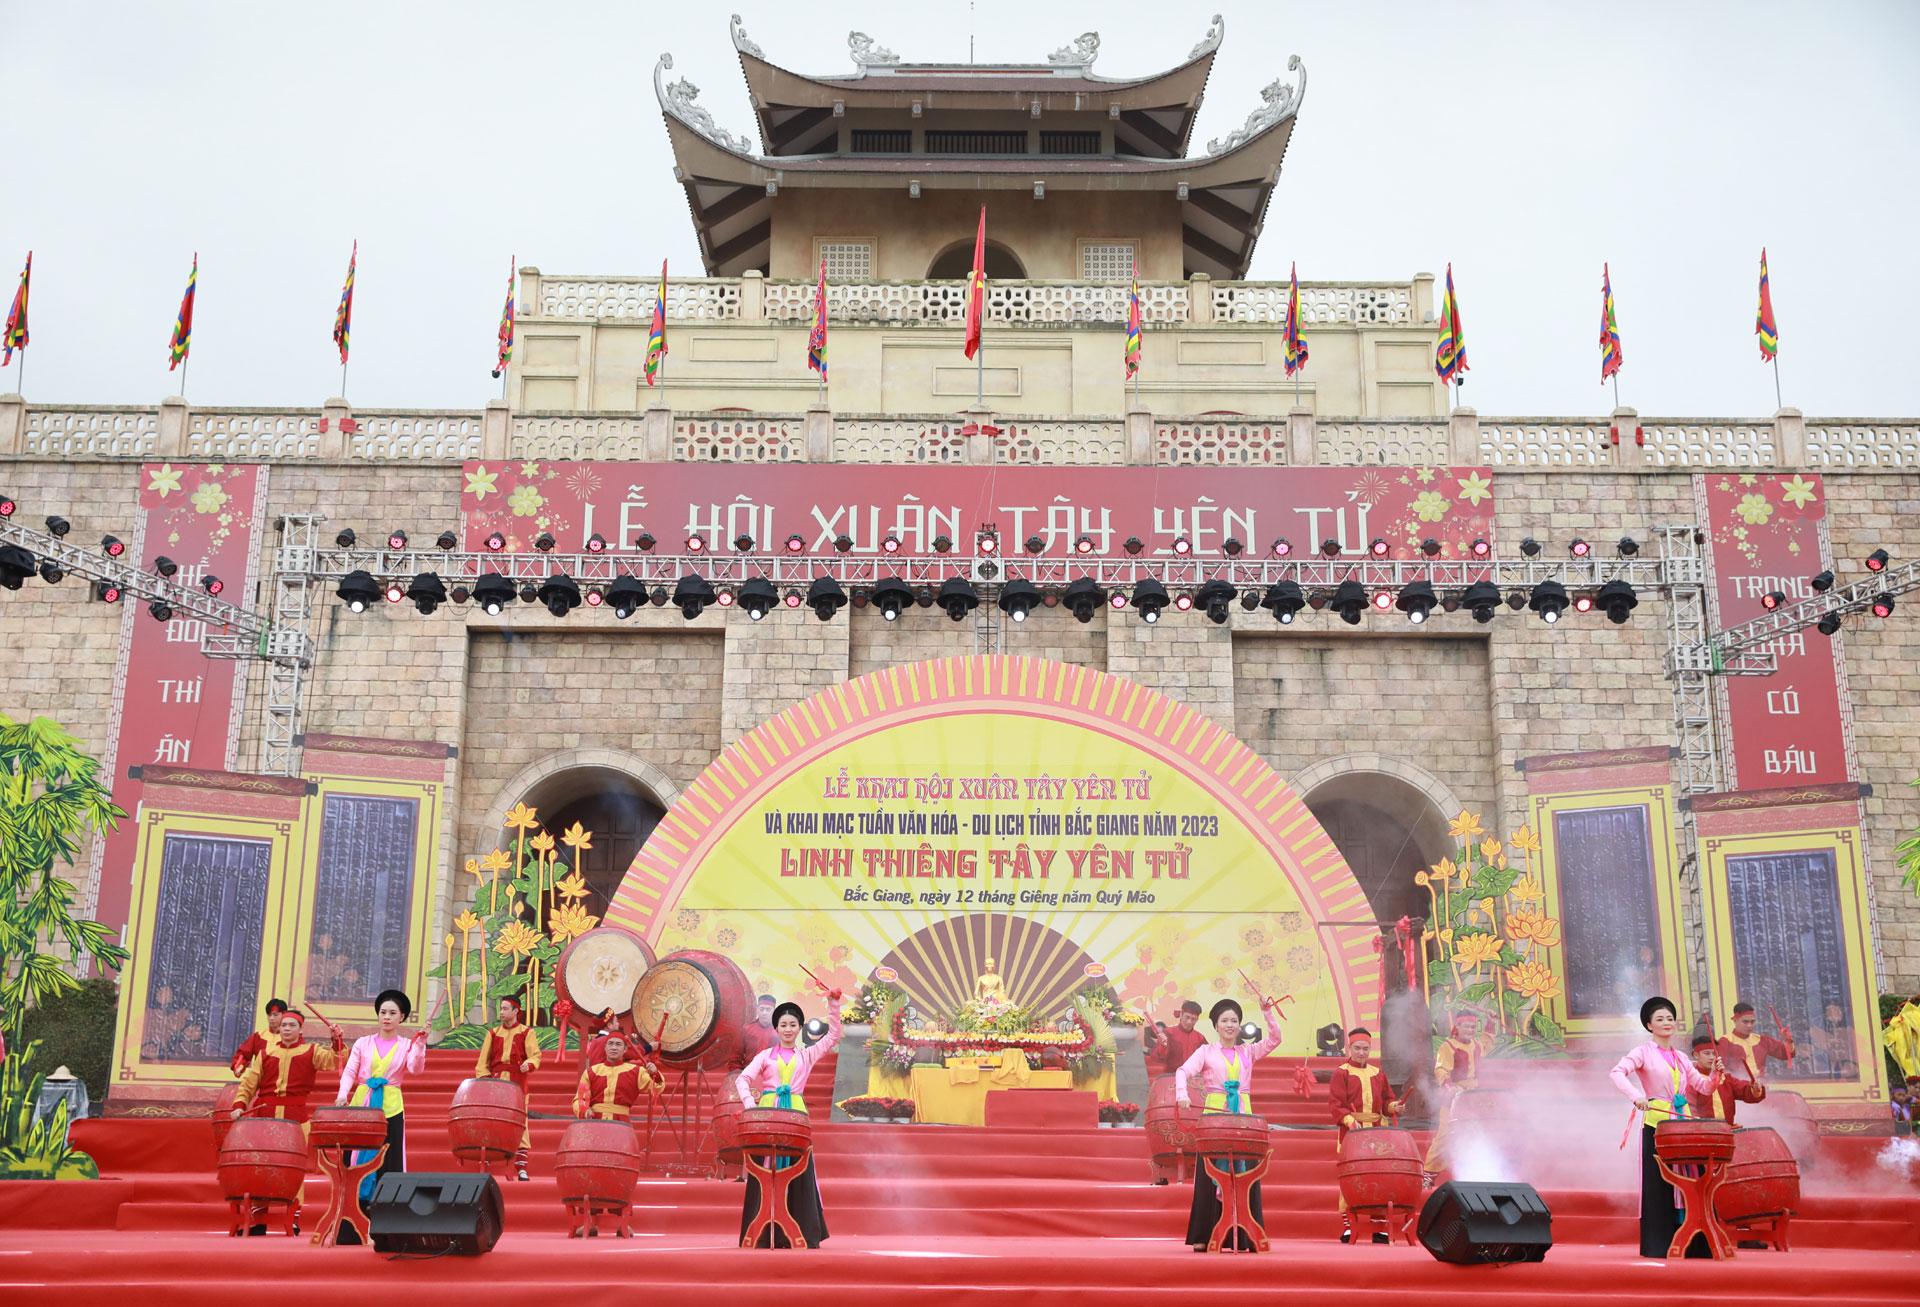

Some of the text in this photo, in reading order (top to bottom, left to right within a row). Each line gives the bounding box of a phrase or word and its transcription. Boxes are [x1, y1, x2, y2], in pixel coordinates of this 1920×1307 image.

[583, 485, 648, 551] LỄ
[810, 493, 962, 553] XUÂN
[998, 495, 1117, 555] TÂY
[1152, 496, 1257, 555] YÊN
[1293, 490, 1373, 556] TỬ
[1728, 575, 1814, 598] TRONG
[157, 675, 203, 703] THÌ
[1766, 686, 1800, 714] CÓ
[152, 733, 191, 764] ĂN
[1763, 744, 1817, 774] BÁU
[823, 767, 1152, 804] LỄ KHAI HỘI XUÂN TÂY YÊN TỬ
[764, 809, 782, 834] VÀ
[786, 813, 818, 834] KHAI
[822, 813, 854, 839] MẠC
[858, 807, 894, 835] TUẦN
[898, 810, 927, 835] VĂN
[931, 809, 958, 835] HÓA
[972, 814, 990, 835] DU
[995, 814, 1024, 840] LỊCH
[1028, 808, 1061, 836] TỈNH
[1065, 807, 1092, 836] BẮC
[1096, 814, 1139, 836] GIANG
[1143, 811, 1177, 836] NĂM
[1181, 815, 1219, 837] 2023
[780, 842, 1193, 880] LINH THIÊNG TÂY YÊN TỬ
[843, 885, 1155, 906] Bắc Giang, ngày 12 tháng Giêng năm Quý Mão
